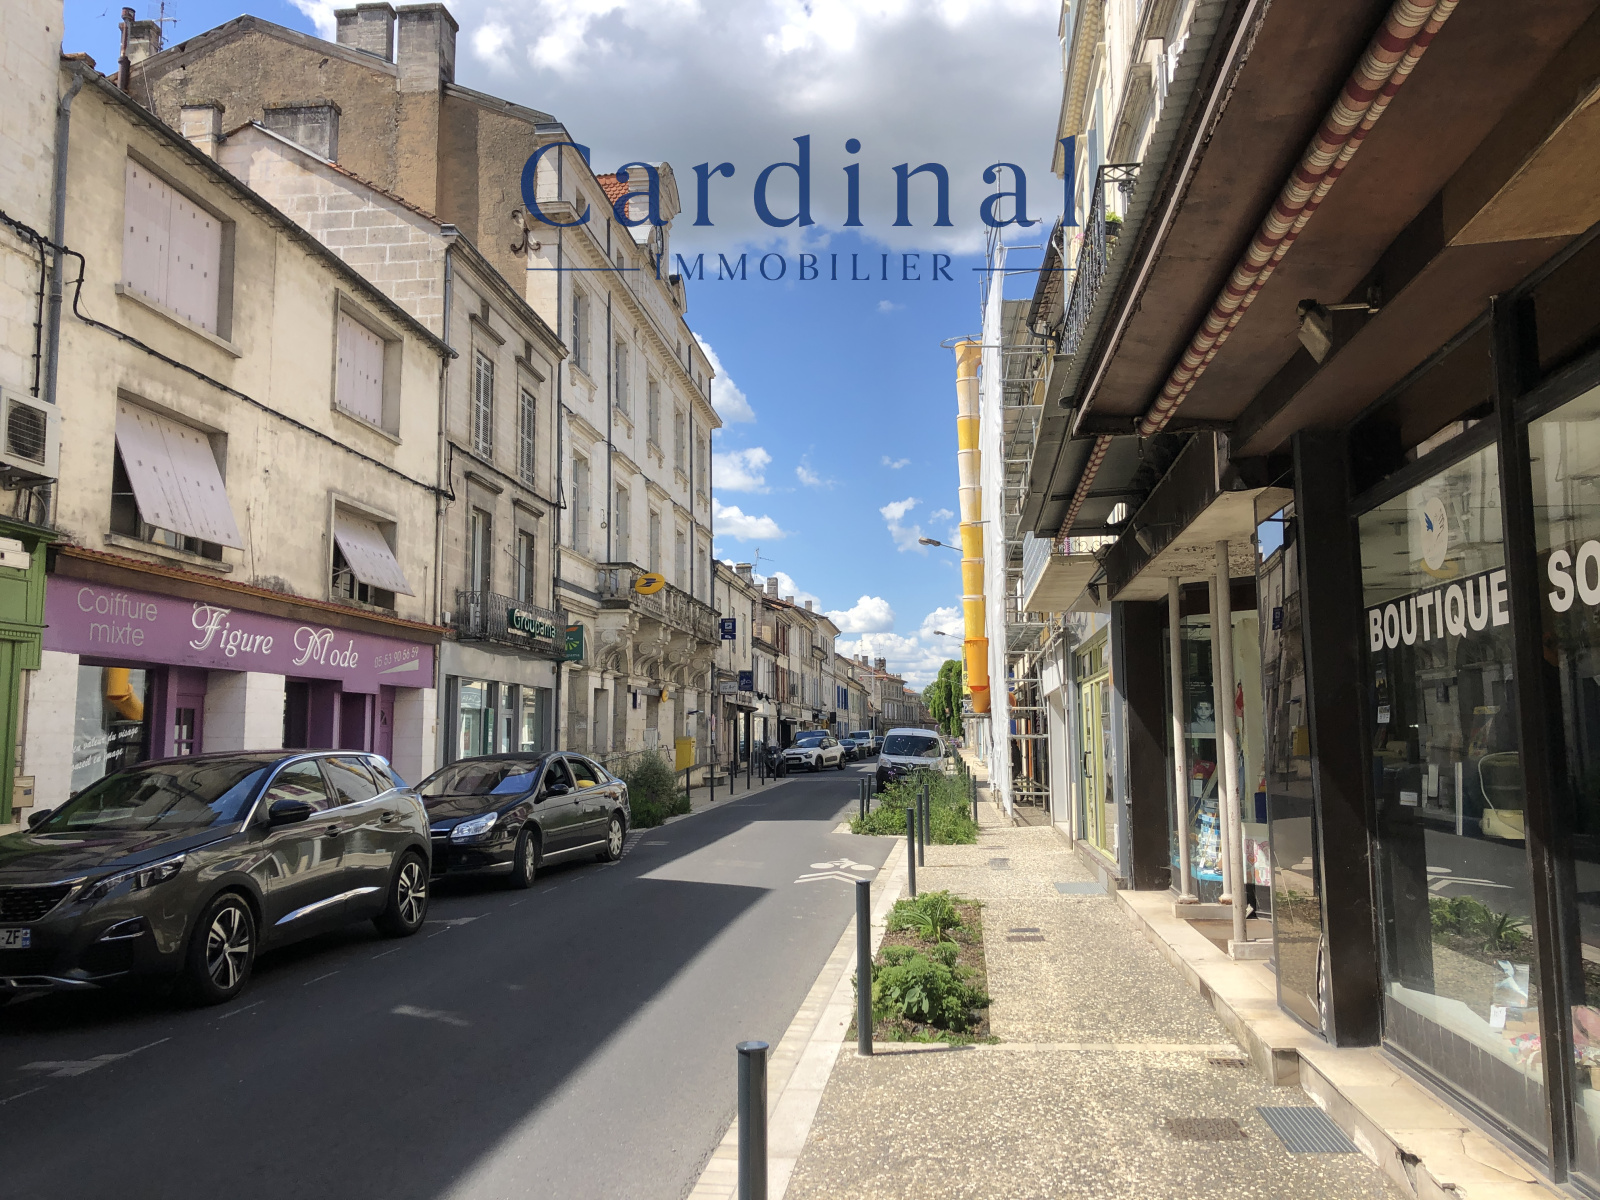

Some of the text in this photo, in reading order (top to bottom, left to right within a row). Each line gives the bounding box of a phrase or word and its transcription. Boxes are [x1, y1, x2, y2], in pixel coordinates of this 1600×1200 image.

[77, 587, 158, 622] Coiffure
[1369, 569, 1510, 652] BOUTIQUE
[89, 620, 144, 647] mixte
[189, 602, 359, 669] Figure Mode
[513, 608, 556, 639] Groupama
[374, 656, 382, 668] 05
